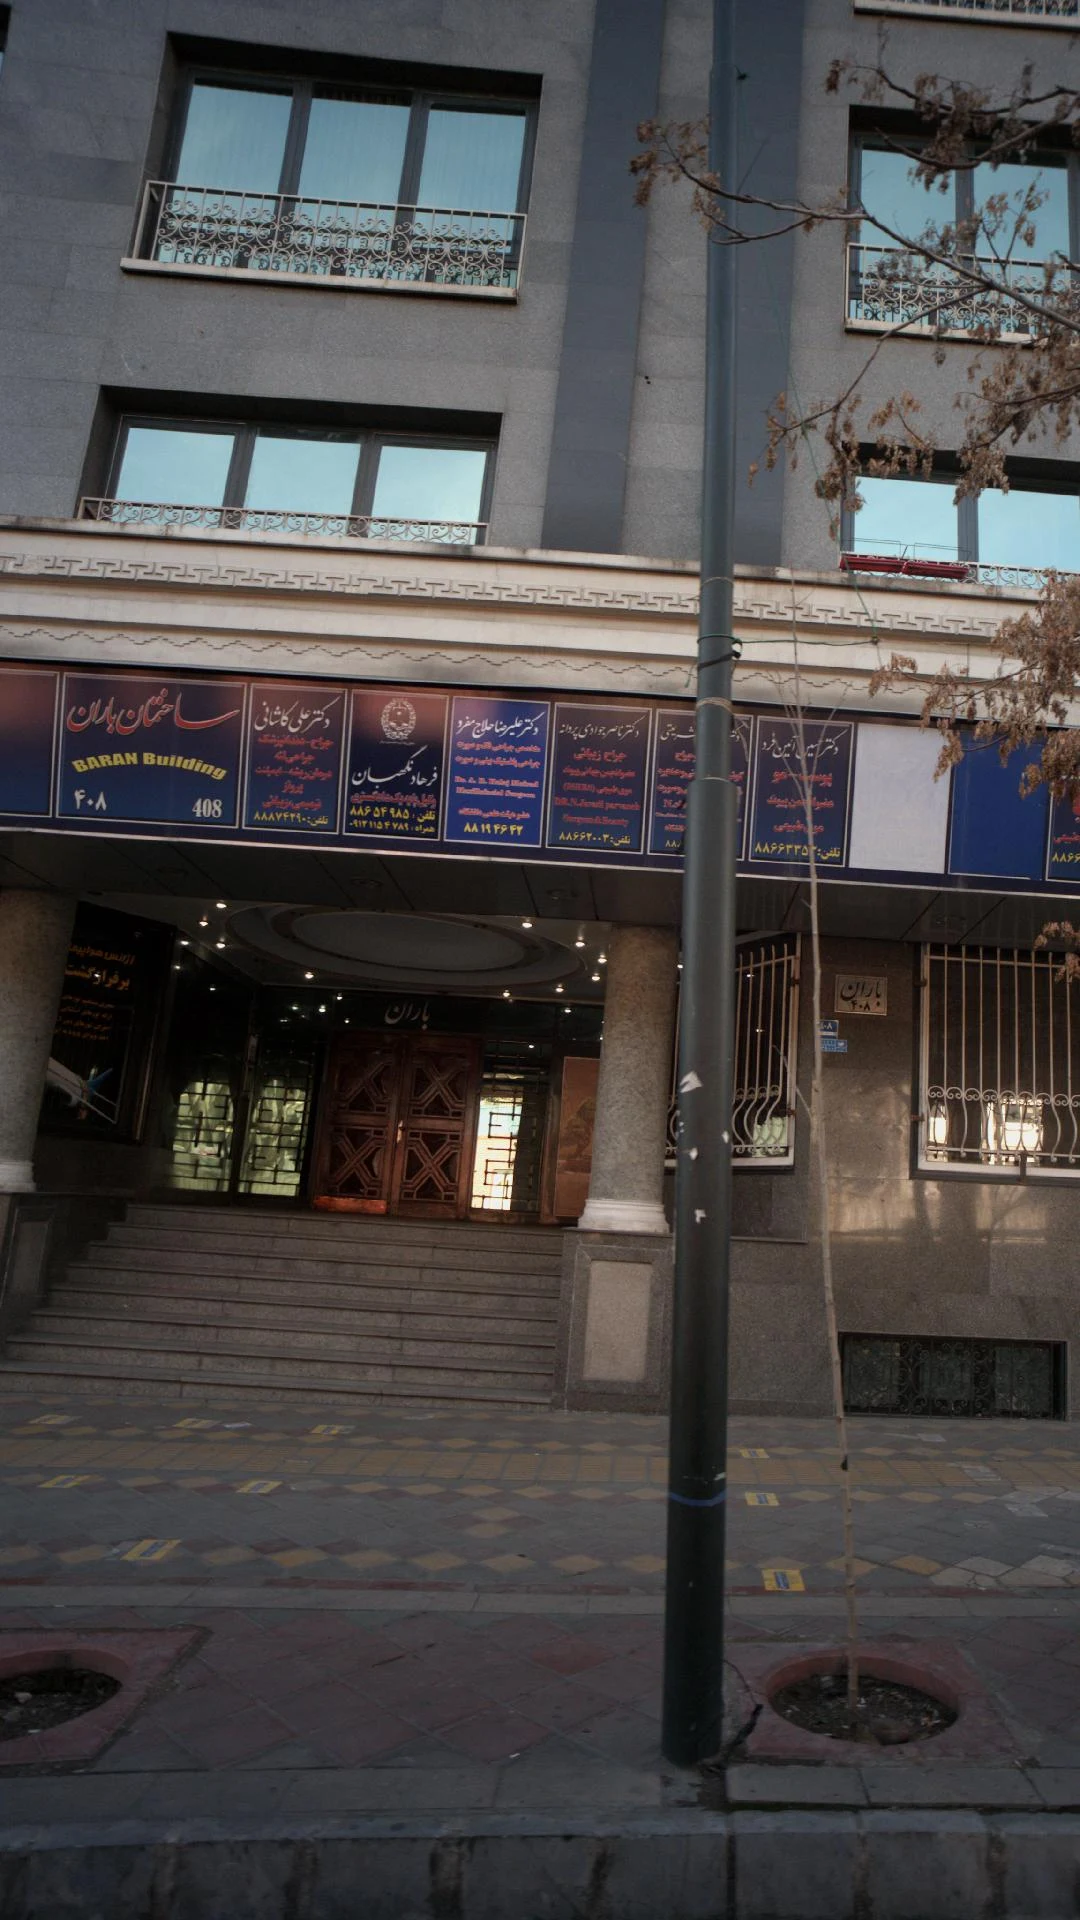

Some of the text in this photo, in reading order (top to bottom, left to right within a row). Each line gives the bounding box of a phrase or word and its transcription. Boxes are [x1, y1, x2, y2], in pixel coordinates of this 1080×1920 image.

[66, 687, 241, 735] ساختمان باران
[253, 695, 341, 733] دکتر علی کاشانی
[517, 711, 546, 738] دکتر
[455, 715, 478, 735] مفرد
[494, 716, 524, 738] علیرضا
[619, 714, 647, 741] دکتر
[71, 752, 228, 781] BARAN Building
[74, 788, 108, 811] ۴۰۸
[192, 797, 223, 819] 408
[840, 980, 882, 1008] باران
[850, 1000, 871, 1011] ۴۰۸
[383, 1000, 431, 1030] باران
